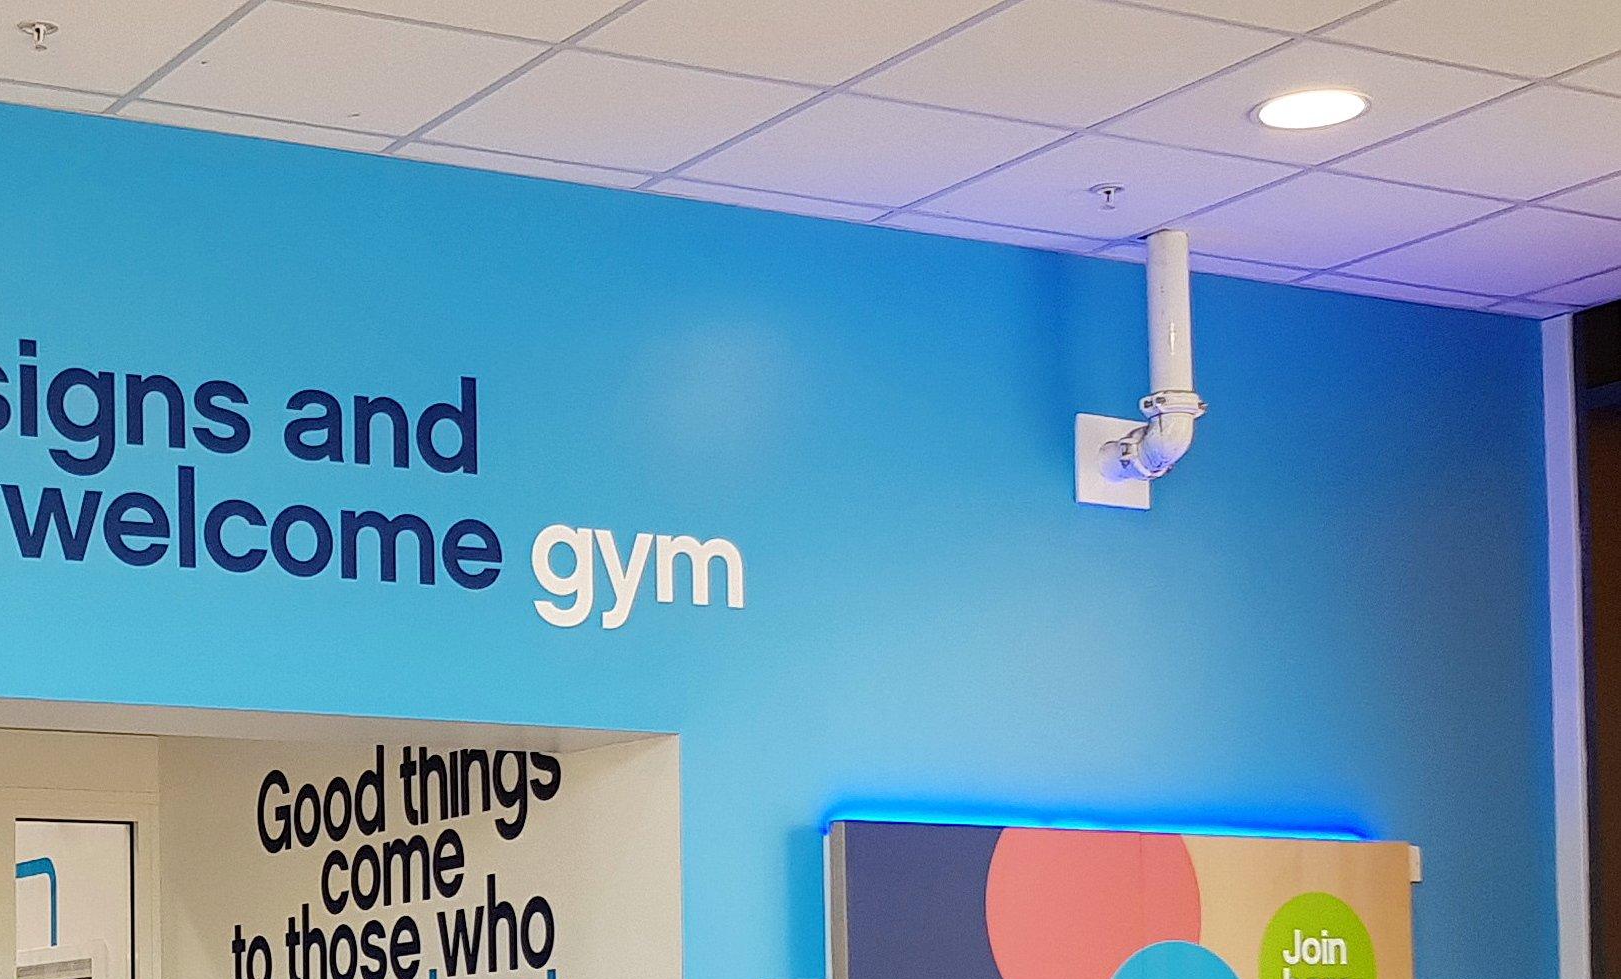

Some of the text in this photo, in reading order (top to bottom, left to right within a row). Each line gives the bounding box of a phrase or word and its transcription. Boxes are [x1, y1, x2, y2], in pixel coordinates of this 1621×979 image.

[283, 376, 478, 475] and
[0, 465, 503, 591] welcome
[532, 523, 745, 630] gym
[257, 744, 562, 853] Good things
[321, 828, 465, 914] come
[437, 873, 555, 977] who
[1282, 928, 1348, 965] Join
